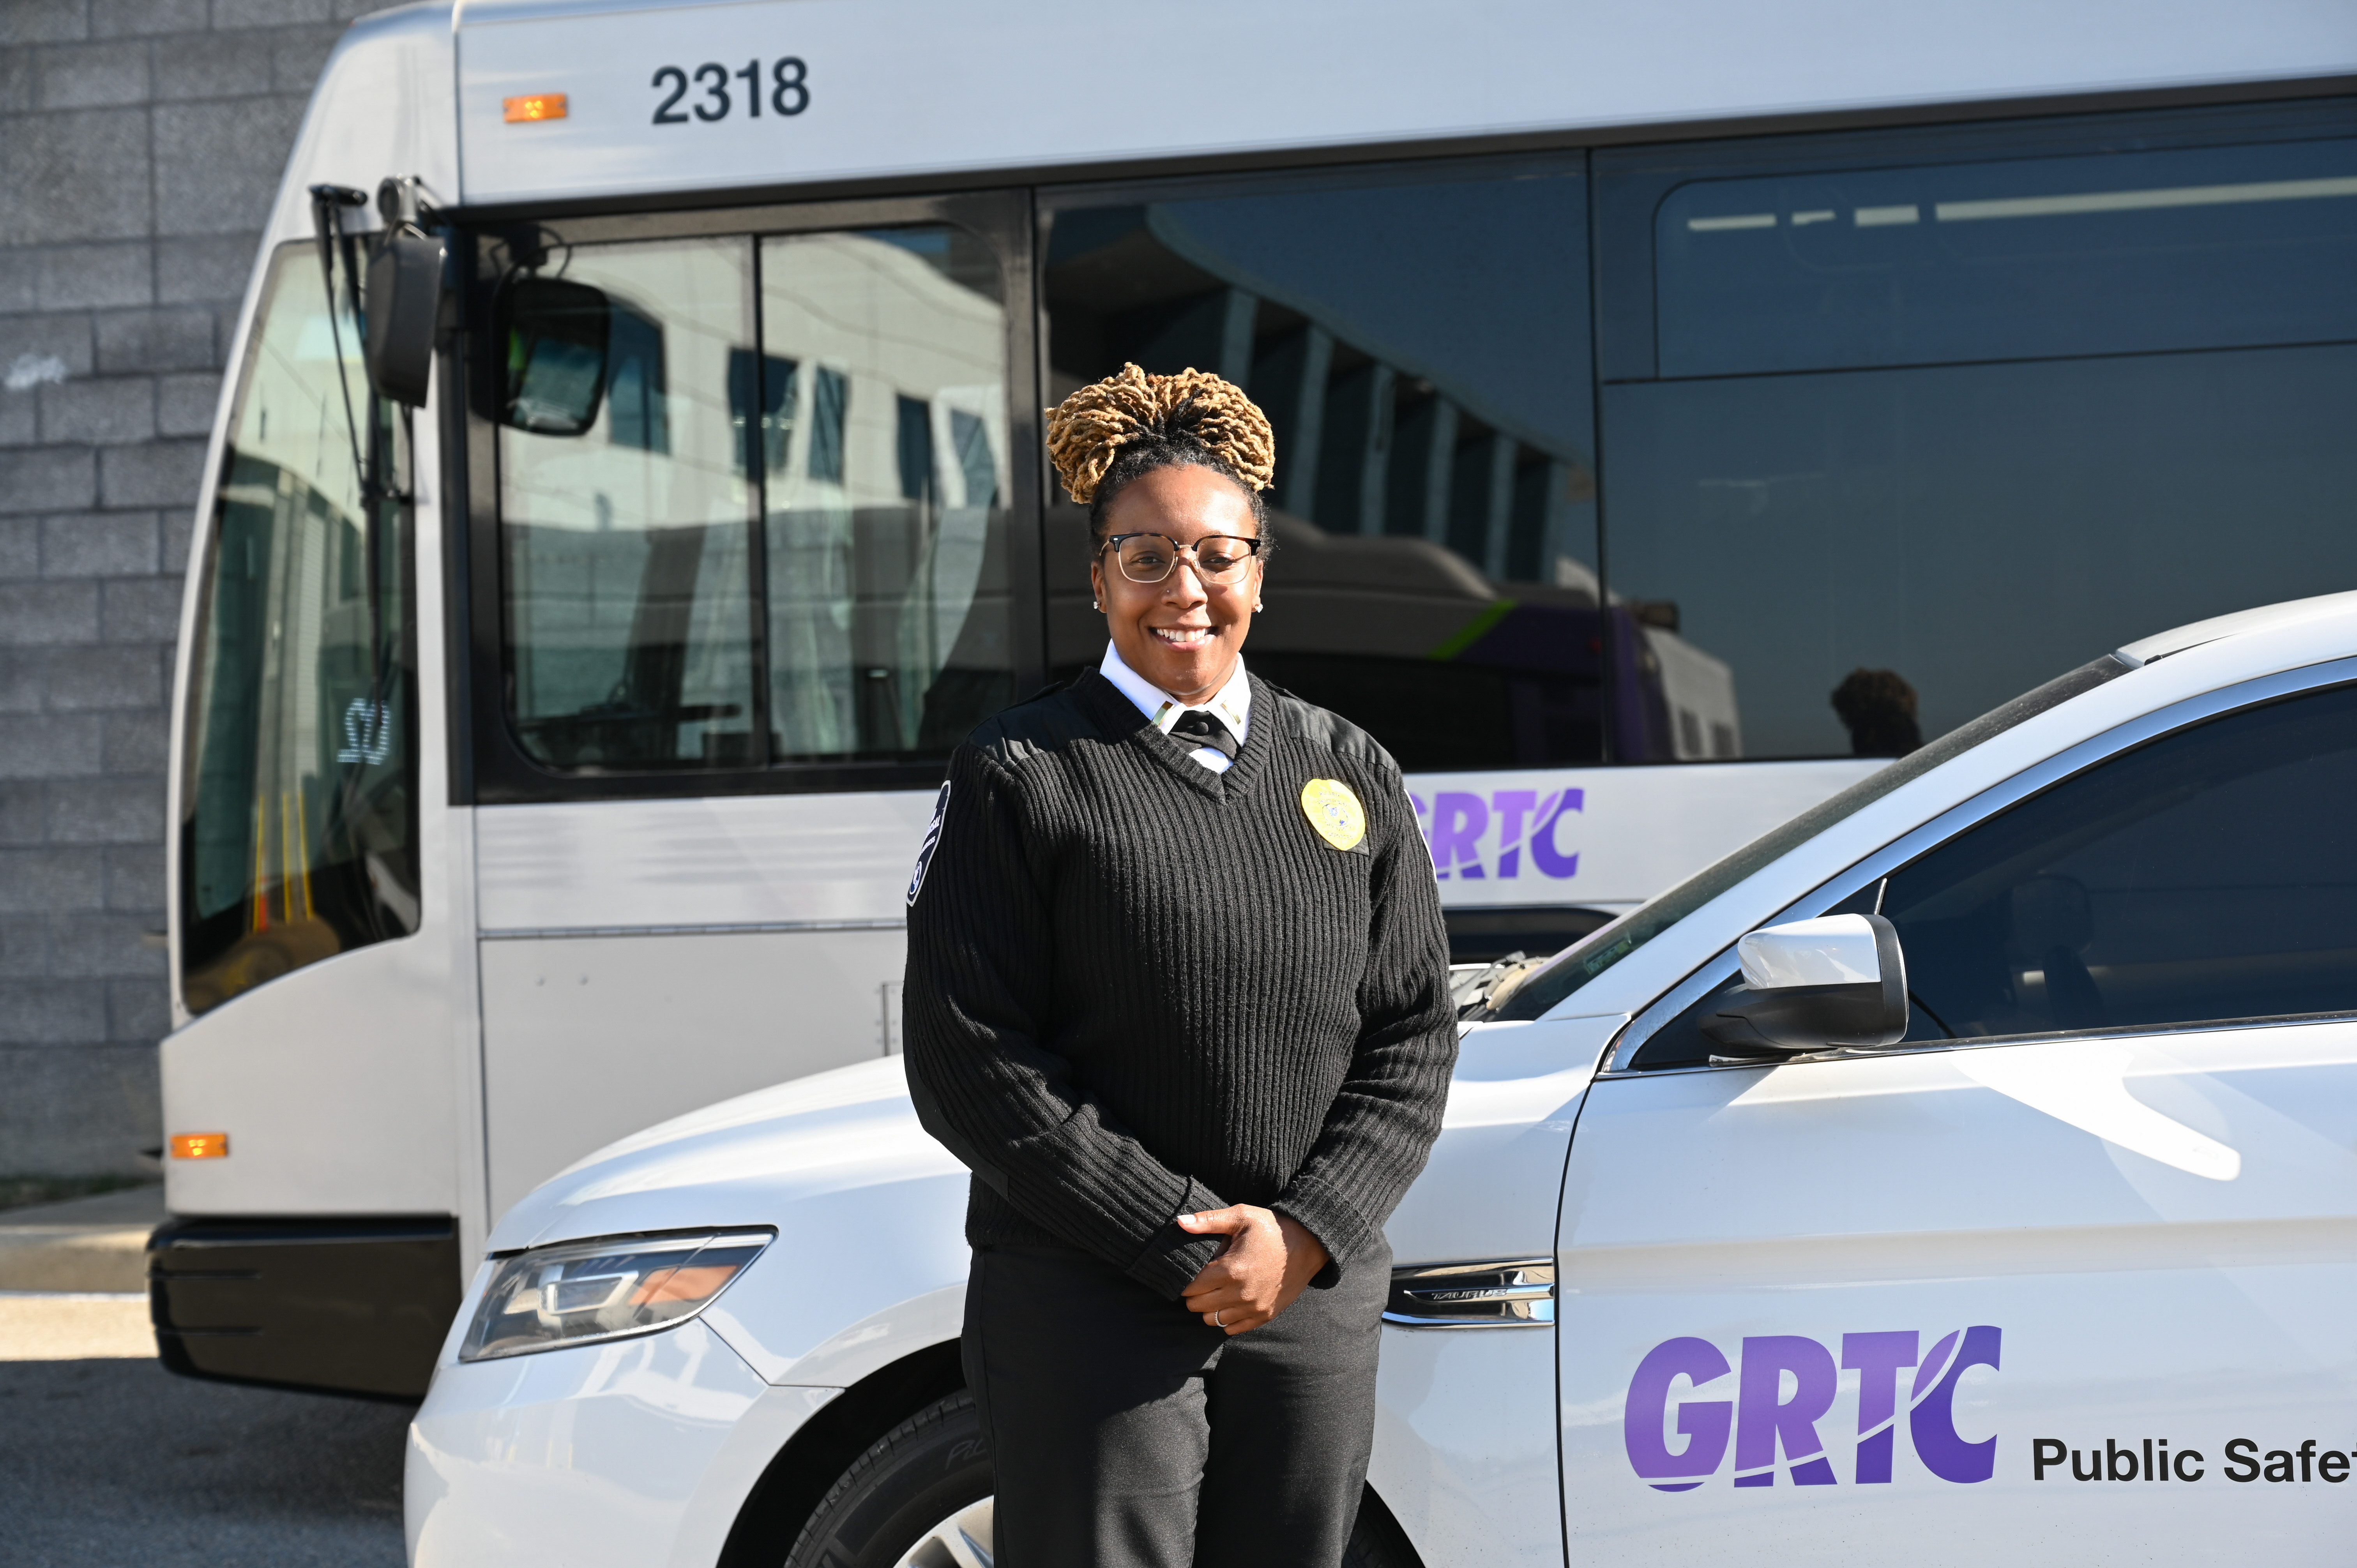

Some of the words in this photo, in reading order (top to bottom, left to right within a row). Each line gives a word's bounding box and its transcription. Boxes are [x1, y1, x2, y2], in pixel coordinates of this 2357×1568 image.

[652, 57, 810, 125] 2318
[1410, 788, 1585, 880] RTC
[1431, 1289, 1507, 1300] TAURUS
[1624, 1326, 2002, 1492] GRTC
[2032, 1438, 2205, 1482] Public
[2223, 1438, 2357, 1483] Safe
